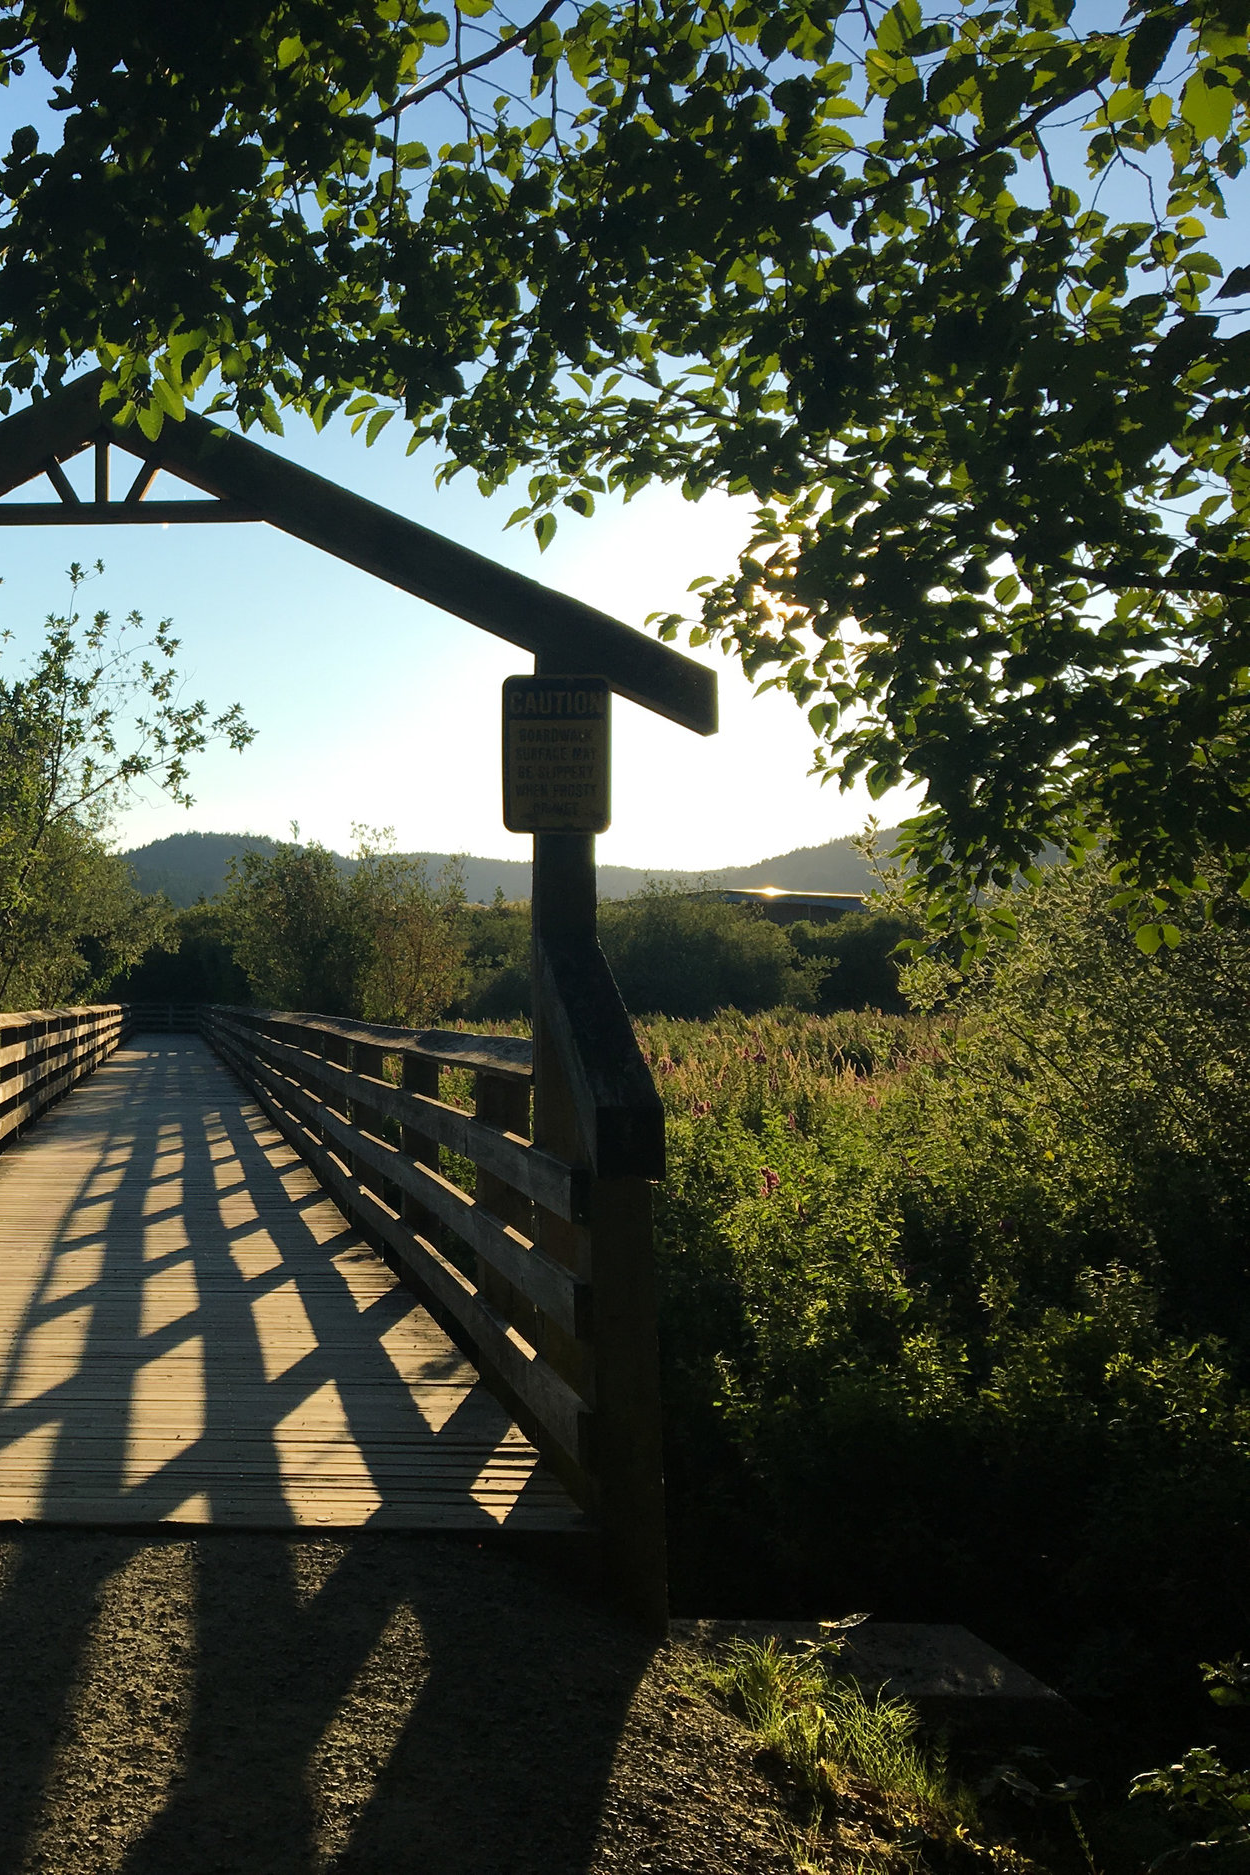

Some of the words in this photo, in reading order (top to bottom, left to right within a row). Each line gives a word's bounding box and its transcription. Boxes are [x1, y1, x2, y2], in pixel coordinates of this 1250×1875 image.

[509, 691, 604, 714] CAUTION
[518, 728, 593, 743] BOARDWALK
[515, 747, 568, 761] SURFACE
[572, 747, 597, 761] MAY
[517, 766, 534, 779] BE
[538, 766, 593, 780] SLIPPERY
[515, 784, 548, 797] WHEN
